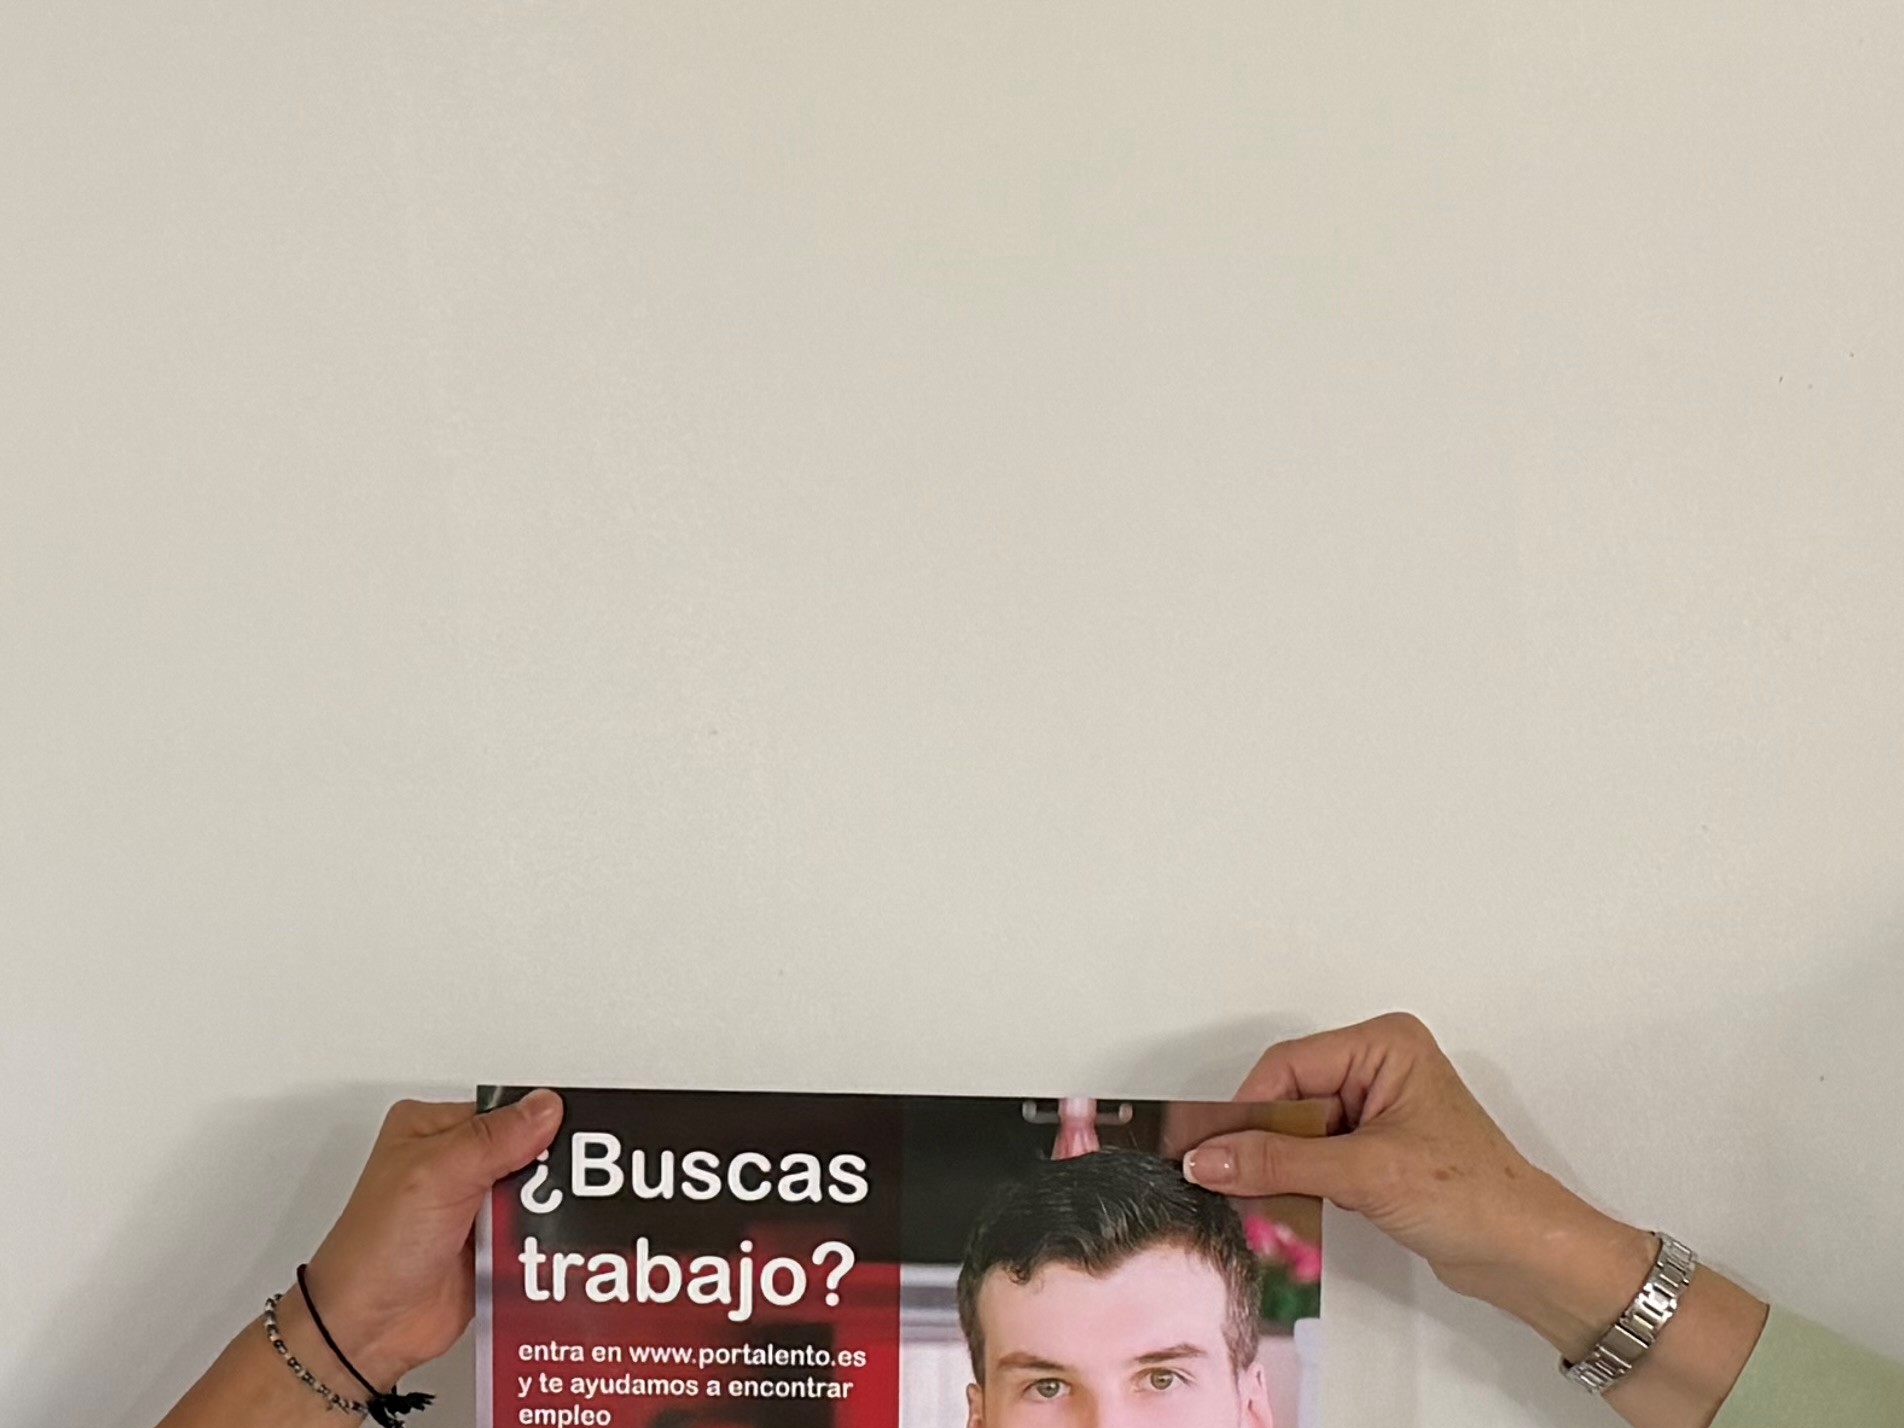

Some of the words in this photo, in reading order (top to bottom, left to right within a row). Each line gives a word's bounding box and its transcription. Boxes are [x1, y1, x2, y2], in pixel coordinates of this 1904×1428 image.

[519, 1131, 870, 1214] ¿Buscas
[517, 1235, 856, 1322] trabajo?
[517, 1341, 585, 1363] entra
[591, 1346, 622, 1363] en
[629, 1345, 867, 1370] www.portalento.es
[517, 1376, 530, 1398] y
[538, 1373, 564, 1394] te
[569, 1374, 698, 1400] ayudamos
[706, 1380, 722, 1397] a
[727, 1378, 854, 1399] encontrar
[517, 1404, 612, 1428] empleo
